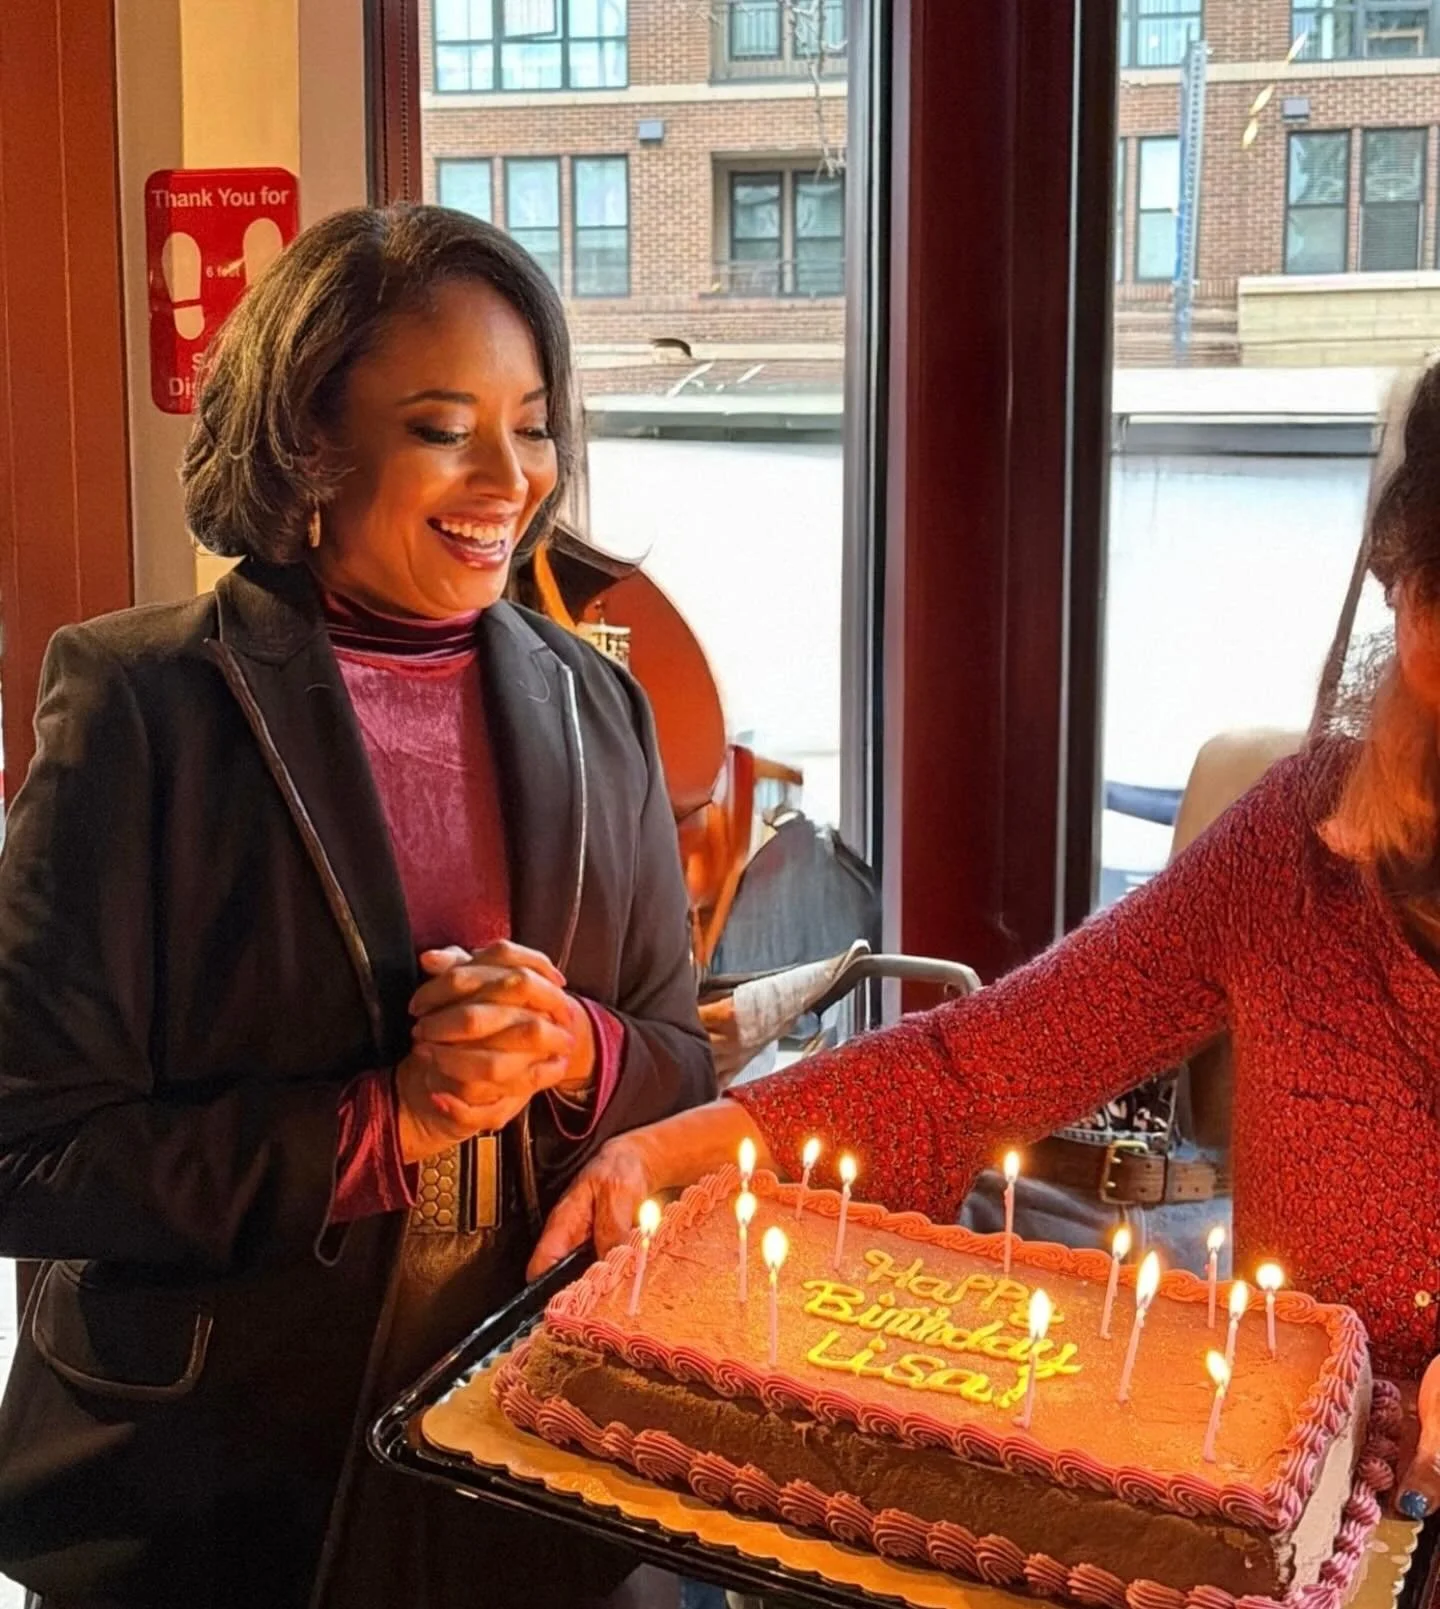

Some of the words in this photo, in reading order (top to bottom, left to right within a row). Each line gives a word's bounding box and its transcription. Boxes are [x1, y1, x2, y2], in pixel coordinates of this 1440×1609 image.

[151, 187, 213, 209] Thank
[218, 187, 256, 207] You
[260, 185, 290, 206] for
[206, 265, 214, 278] 6
